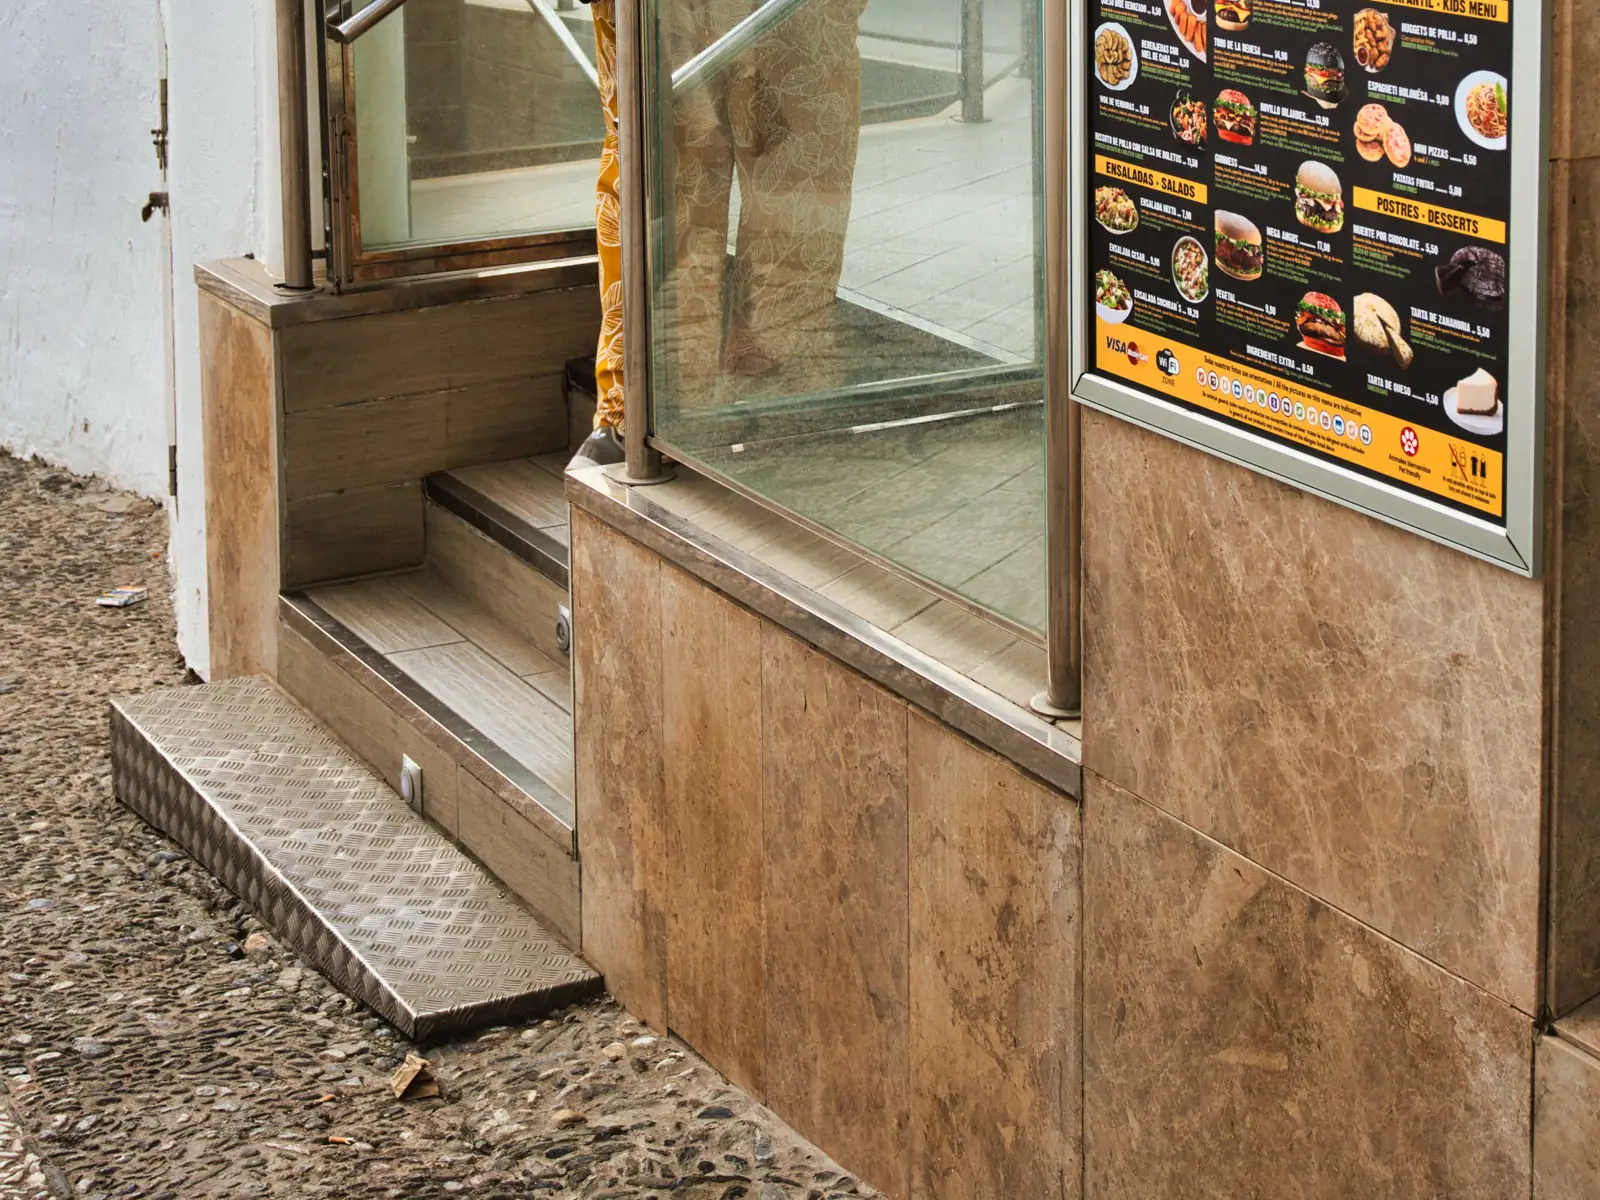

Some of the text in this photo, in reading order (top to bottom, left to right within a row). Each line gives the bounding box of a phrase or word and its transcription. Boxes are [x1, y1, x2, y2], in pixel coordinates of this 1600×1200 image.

[1125, 0, 1146, 13] REBOZADO
[1469, 1, 1497, 18] MENU
[1401, 23, 1456, 41] NUGGETS DE POLLO
[1141, 40, 1179, 56] BERENJENAS CON
[1227, 40, 1233, 50] DE
[1234, 42, 1241, 51] LA
[1141, 50, 1158, 61] MIEL DE
[1368, 81, 1398, 97] ESPAGUETI
[1109, 97, 1115, 105] DE
[1260, 103, 1280, 114] NOVILLO
[1113, 137, 1118, 146] DE
[1119, 139, 1132, 150] POLLO
[1133, 142, 1141, 152] CON
[1142, 144, 1155, 158] SALSA
[1156, 150, 1162, 158] DE
[1414, 143, 1477, 166] MINI PIZZAS 6,50
[1106, 162, 1154, 186] ENSALADAS
[1161, 177, 1195, 198] SALADS
[1393, 173, 1462, 197] PATATAS FRITAS 5,00
[1141, 197, 1163, 211] ENSALADA
[1164, 203, 1176, 216] MIXTA
[1377, 197, 1479, 234] POSTRES DESSERTS
[1266, 226, 1280, 238] MEGA
[1353, 224, 1438, 256] MUERTE POR CHOCOLATE 5,50
[1109, 243, 1131, 257] ENSALADA
[1134, 289, 1157, 305] ENSALADA
[1216, 288, 1236, 302] VEGETAL
[1410, 307, 1490, 338] TARTA DE ZANAHORIA 5,50
[1106, 336, 1126, 355] VISA
[1247, 345, 1278, 363] INGREDIENTE
[1279, 355, 1295, 369] EXTRA
[1162, 376, 1175, 387] ZONE
[1367, 374, 1438, 406] TARTA DE QUESO 5,50
[1231, 364, 1241, 375] fotos
[1250, 370, 1272, 385] orientativas
[1290, 384, 1306, 398] pictures
[1312, 391, 1320, 402] this
[1322, 397, 1333, 406] menu
[1341, 402, 1362, 417] indicative
[1389, 454, 1431, 474] Animales bienvenidos
[1406, 468, 1421, 480] friendly
